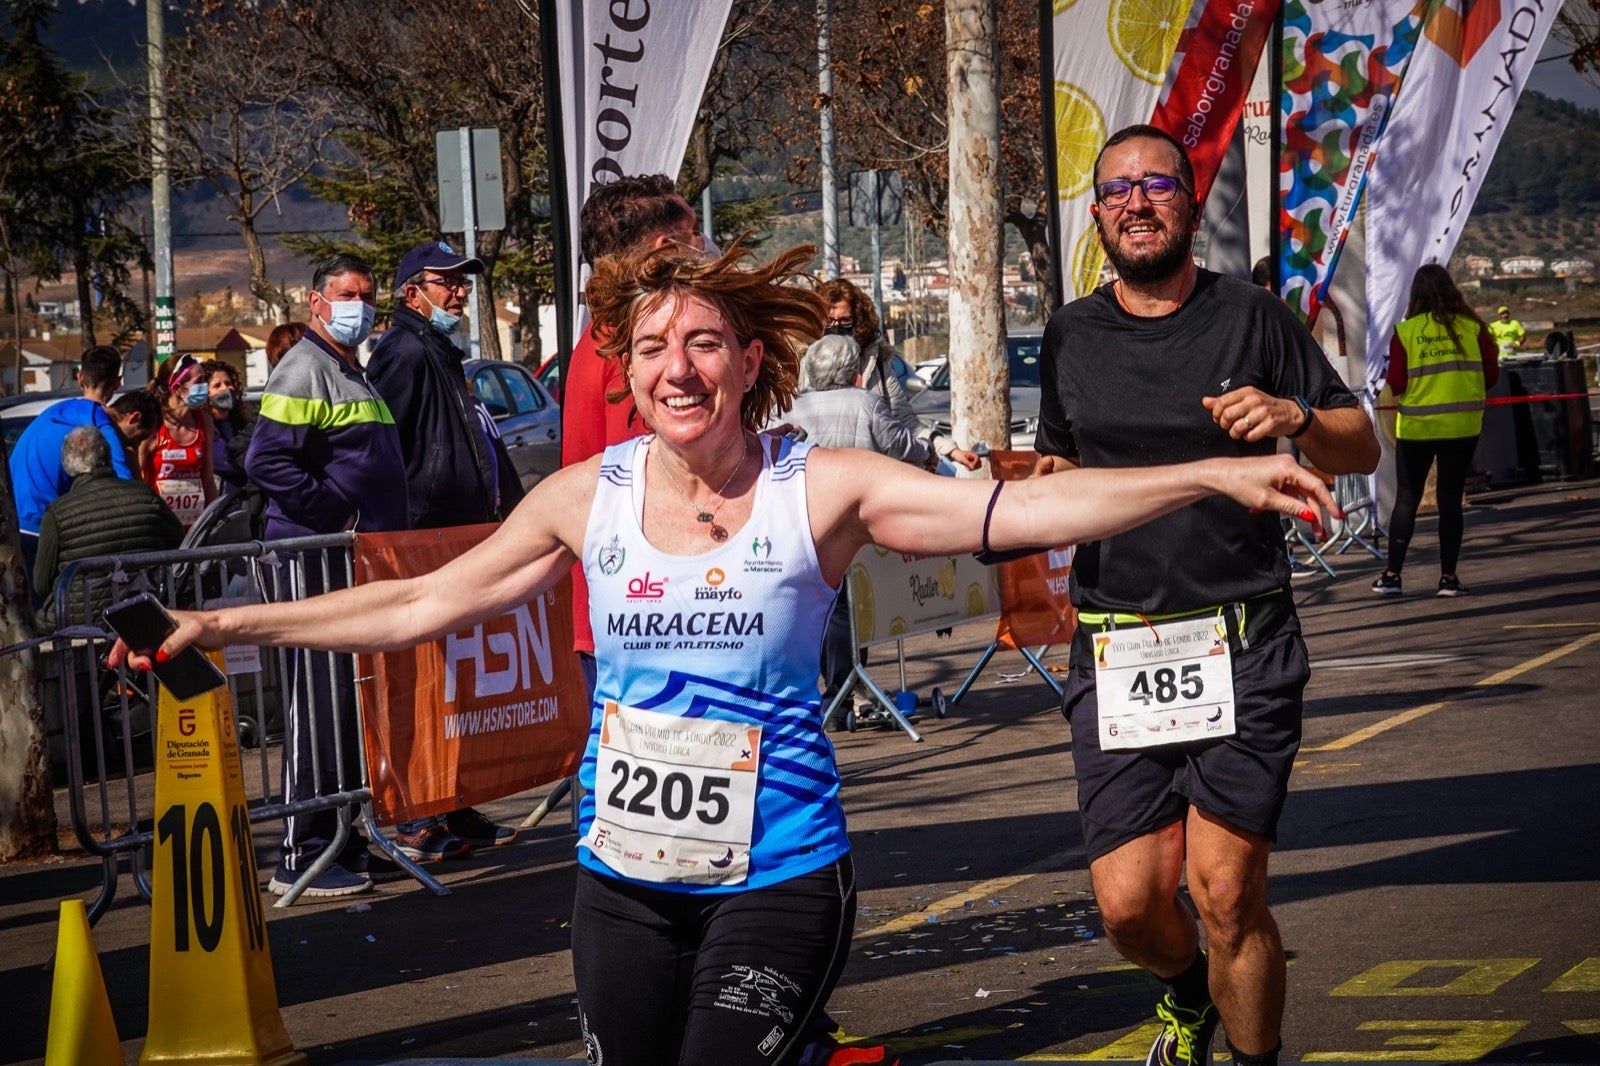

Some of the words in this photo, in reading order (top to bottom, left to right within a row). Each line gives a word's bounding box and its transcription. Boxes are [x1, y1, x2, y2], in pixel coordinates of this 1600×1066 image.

[1327, 102, 1383, 256] www.turgranada.es
[166, 495, 200, 510] 2107
[695, 587, 742, 602] mayfo
[910, 574, 940, 606] Radler
[607, 611, 765, 636] MARACENA
[1192, 630, 1209, 642] 2022
[445, 593, 554, 703] HSN
[623, 641, 651, 651] CLUB
[655, 640, 671, 650] DE
[674, 640, 744, 650] ATLETISMO
[1128, 664, 1204, 706] 485
[444, 696, 559, 740] WWW.HSNSTORE.COM
[166, 739, 210, 750] Diputación
[166, 749, 177, 759] de
[177, 748, 210, 758] Granada
[713, 732, 737, 748] 2022
[607, 759, 731, 825] 2205
[158, 802, 225, 952] 10
[231, 804, 263, 952] 10
